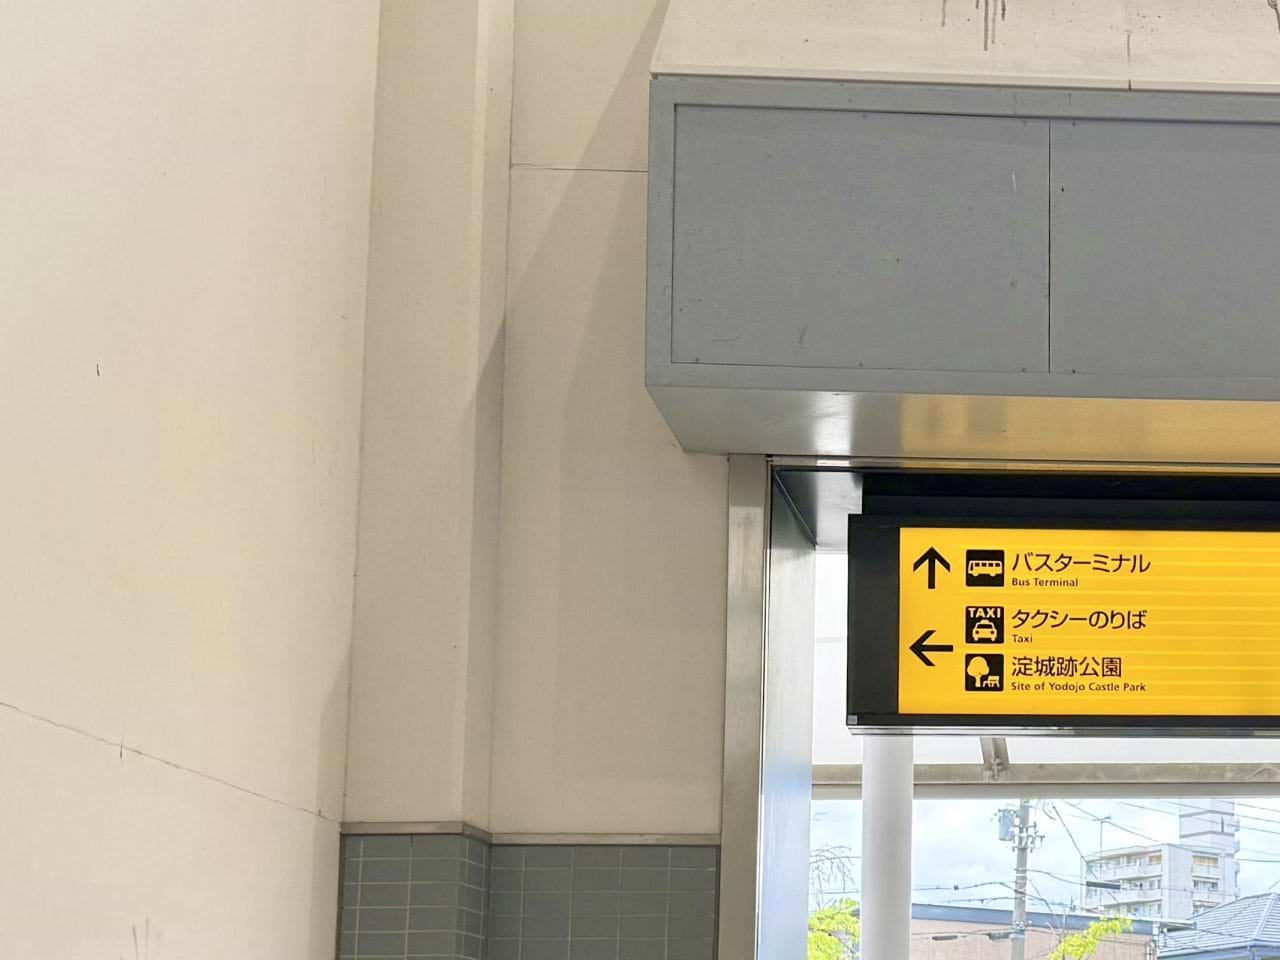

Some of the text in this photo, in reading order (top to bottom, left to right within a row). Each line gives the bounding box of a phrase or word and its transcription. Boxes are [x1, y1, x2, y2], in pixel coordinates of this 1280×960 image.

[1011, 552, 1151, 573] バスターミナル
[1012, 578, 1078, 587] Bus Terminal
[968, 607, 1001, 618] TAXI
[1011, 609, 1147, 629] タクシーのりば
[1012, 633, 1033, 643] Taxi
[1011, 656, 1122, 677] 淀城跡公園
[1011, 682, 1146, 692] Site of Yodojo Castle Park
